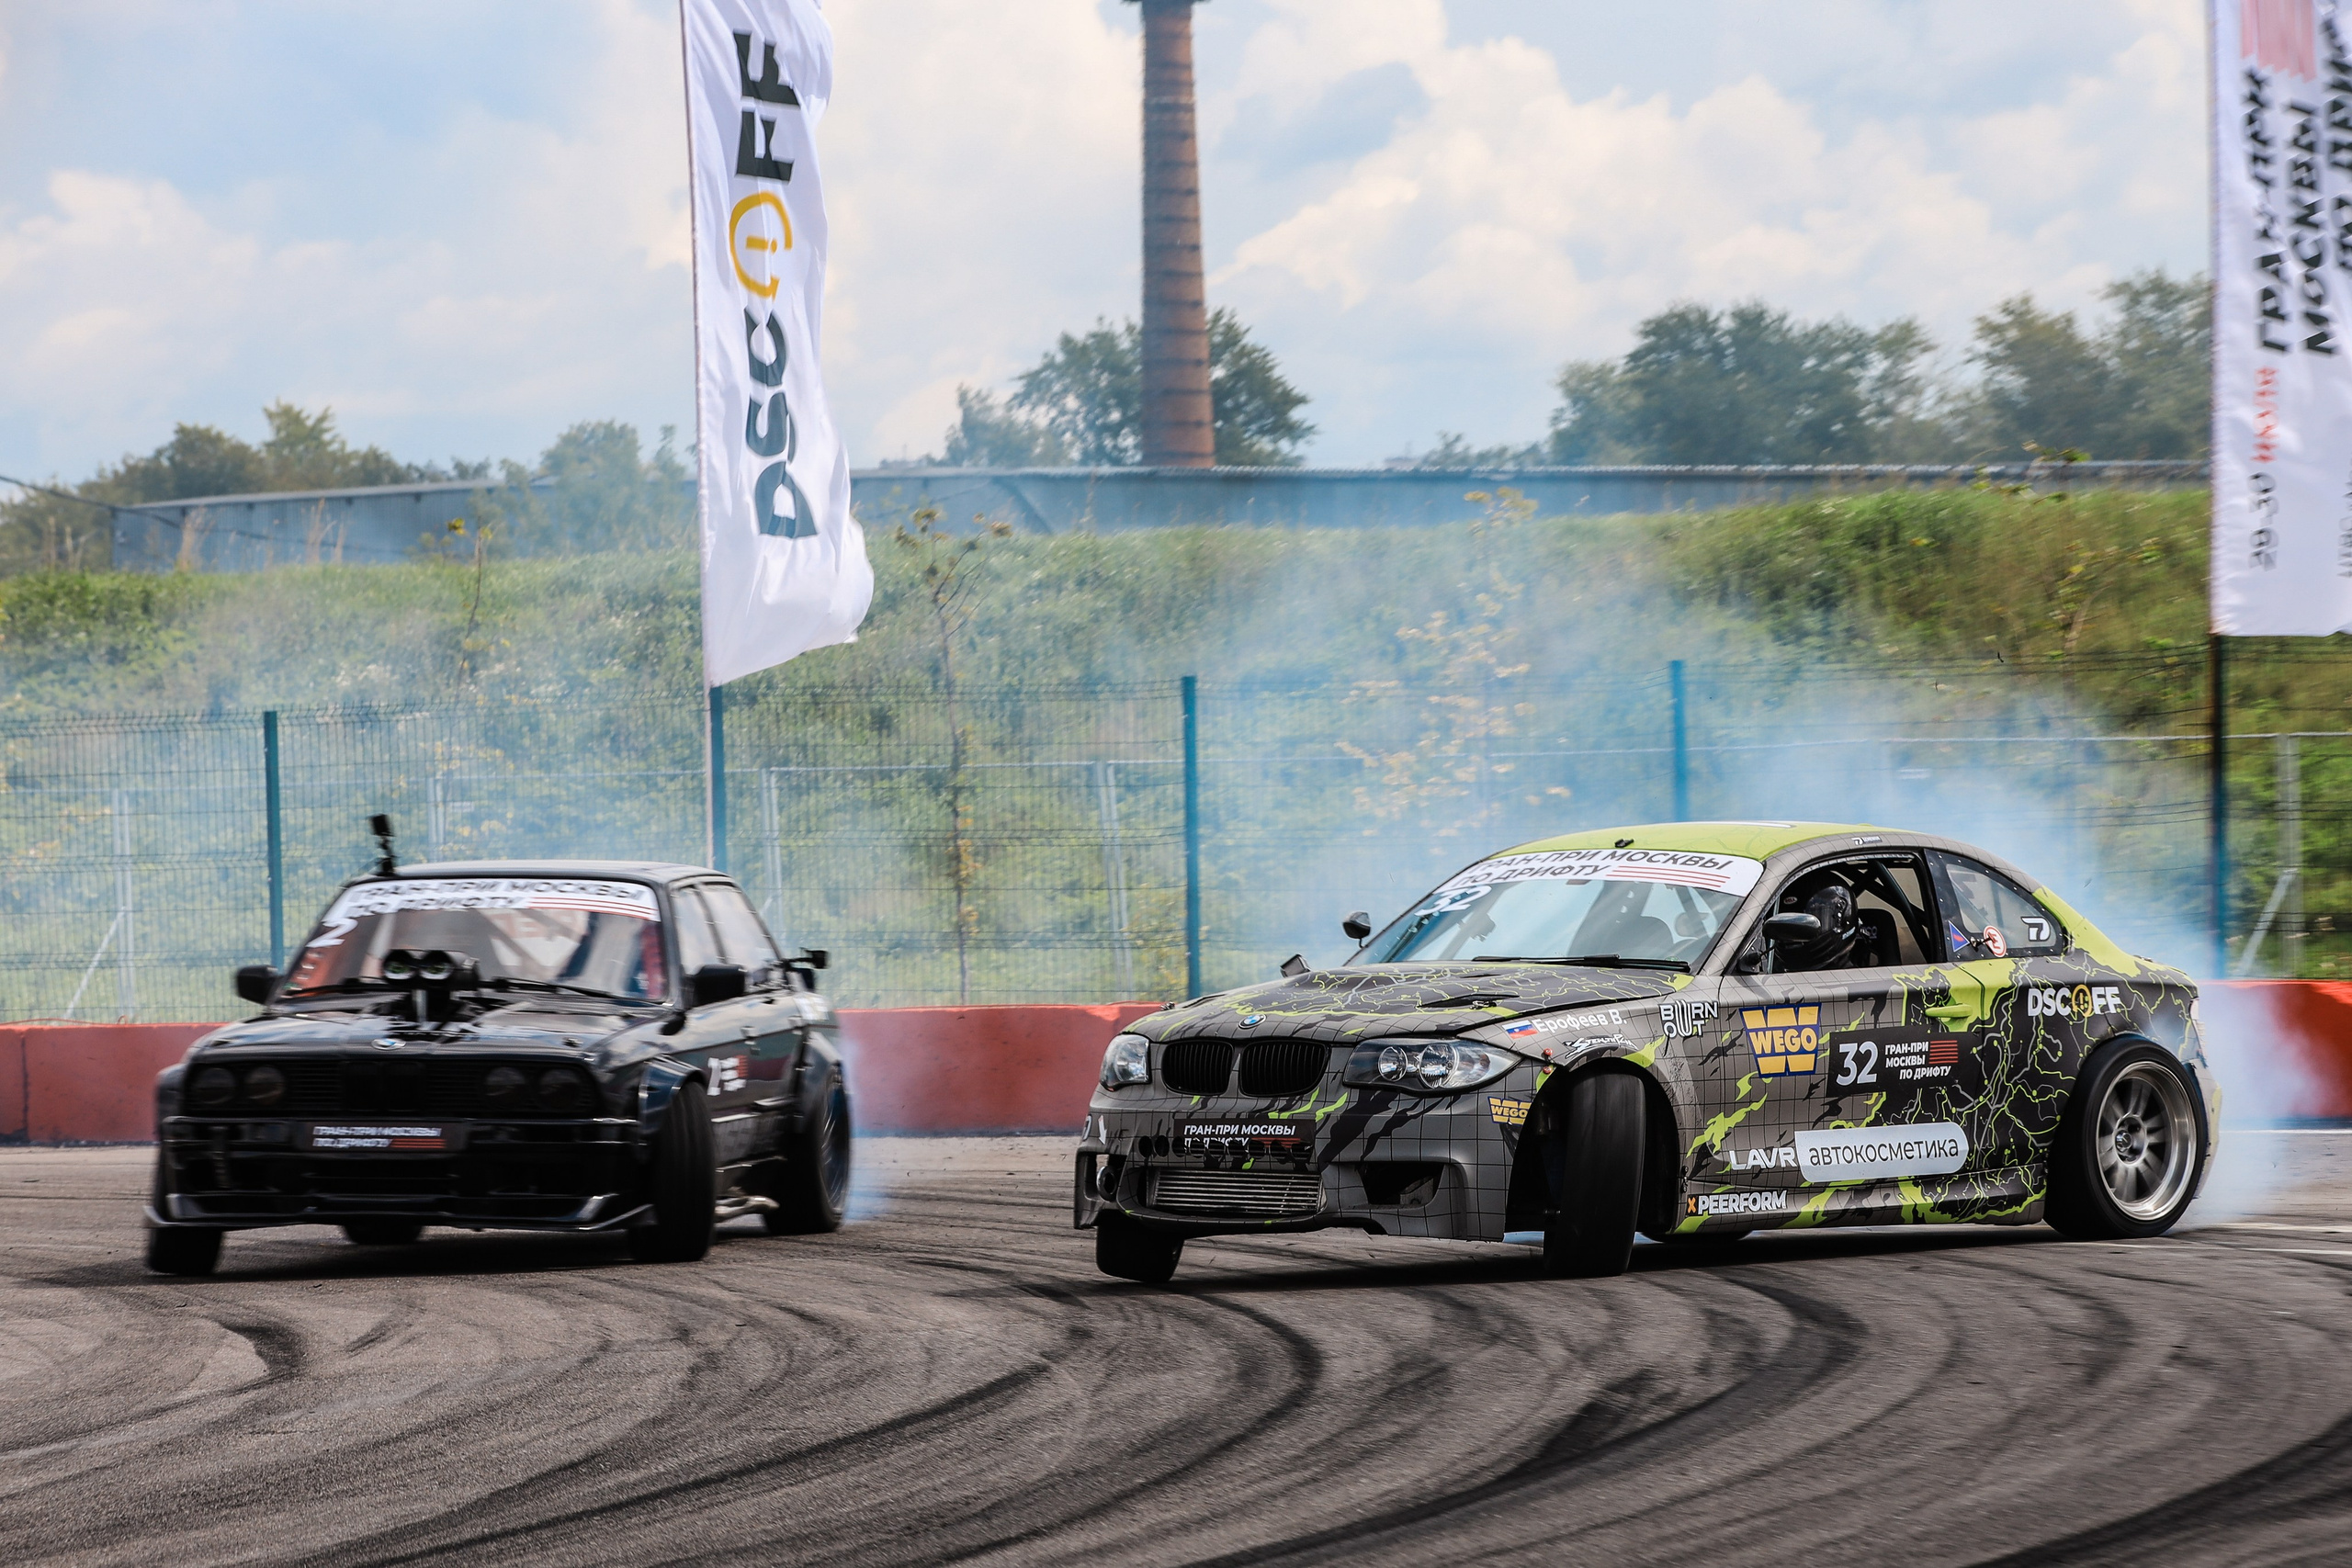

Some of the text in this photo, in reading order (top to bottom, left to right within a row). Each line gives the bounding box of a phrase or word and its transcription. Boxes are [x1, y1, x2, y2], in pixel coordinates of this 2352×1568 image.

[2280, 96, 2338, 355] МОСКВЫ
[1474, 851, 1734, 870] ГРАН-ПРИ МОСКВЫ
[1490, 864, 1613, 883] ДРИФТУ
[1414, 886, 1492, 917] 32
[305, 919, 357, 947] 2
[1532, 1009, 1628, 1032] Ерофеев В.
[1659, 1000, 1718, 1025] BURN
[1748, 1027, 1817, 1055] WEGO
[1884, 1041, 1929, 1055] ГРАН-ПРИ
[1837, 1041, 1878, 1086] 32
[1885, 1055, 1926, 1068] МОСКВЫ
[1899, 1066, 1951, 1080] ПО ДРИФТУ
[1491, 1105, 1529, 1118] WEGO
[1183, 1124, 1296, 1135] ГРАН-ПРИ МОСКВЫ
[1729, 1146, 1797, 1170] LAVR
[1808, 1137, 1959, 1167] автокосметика
